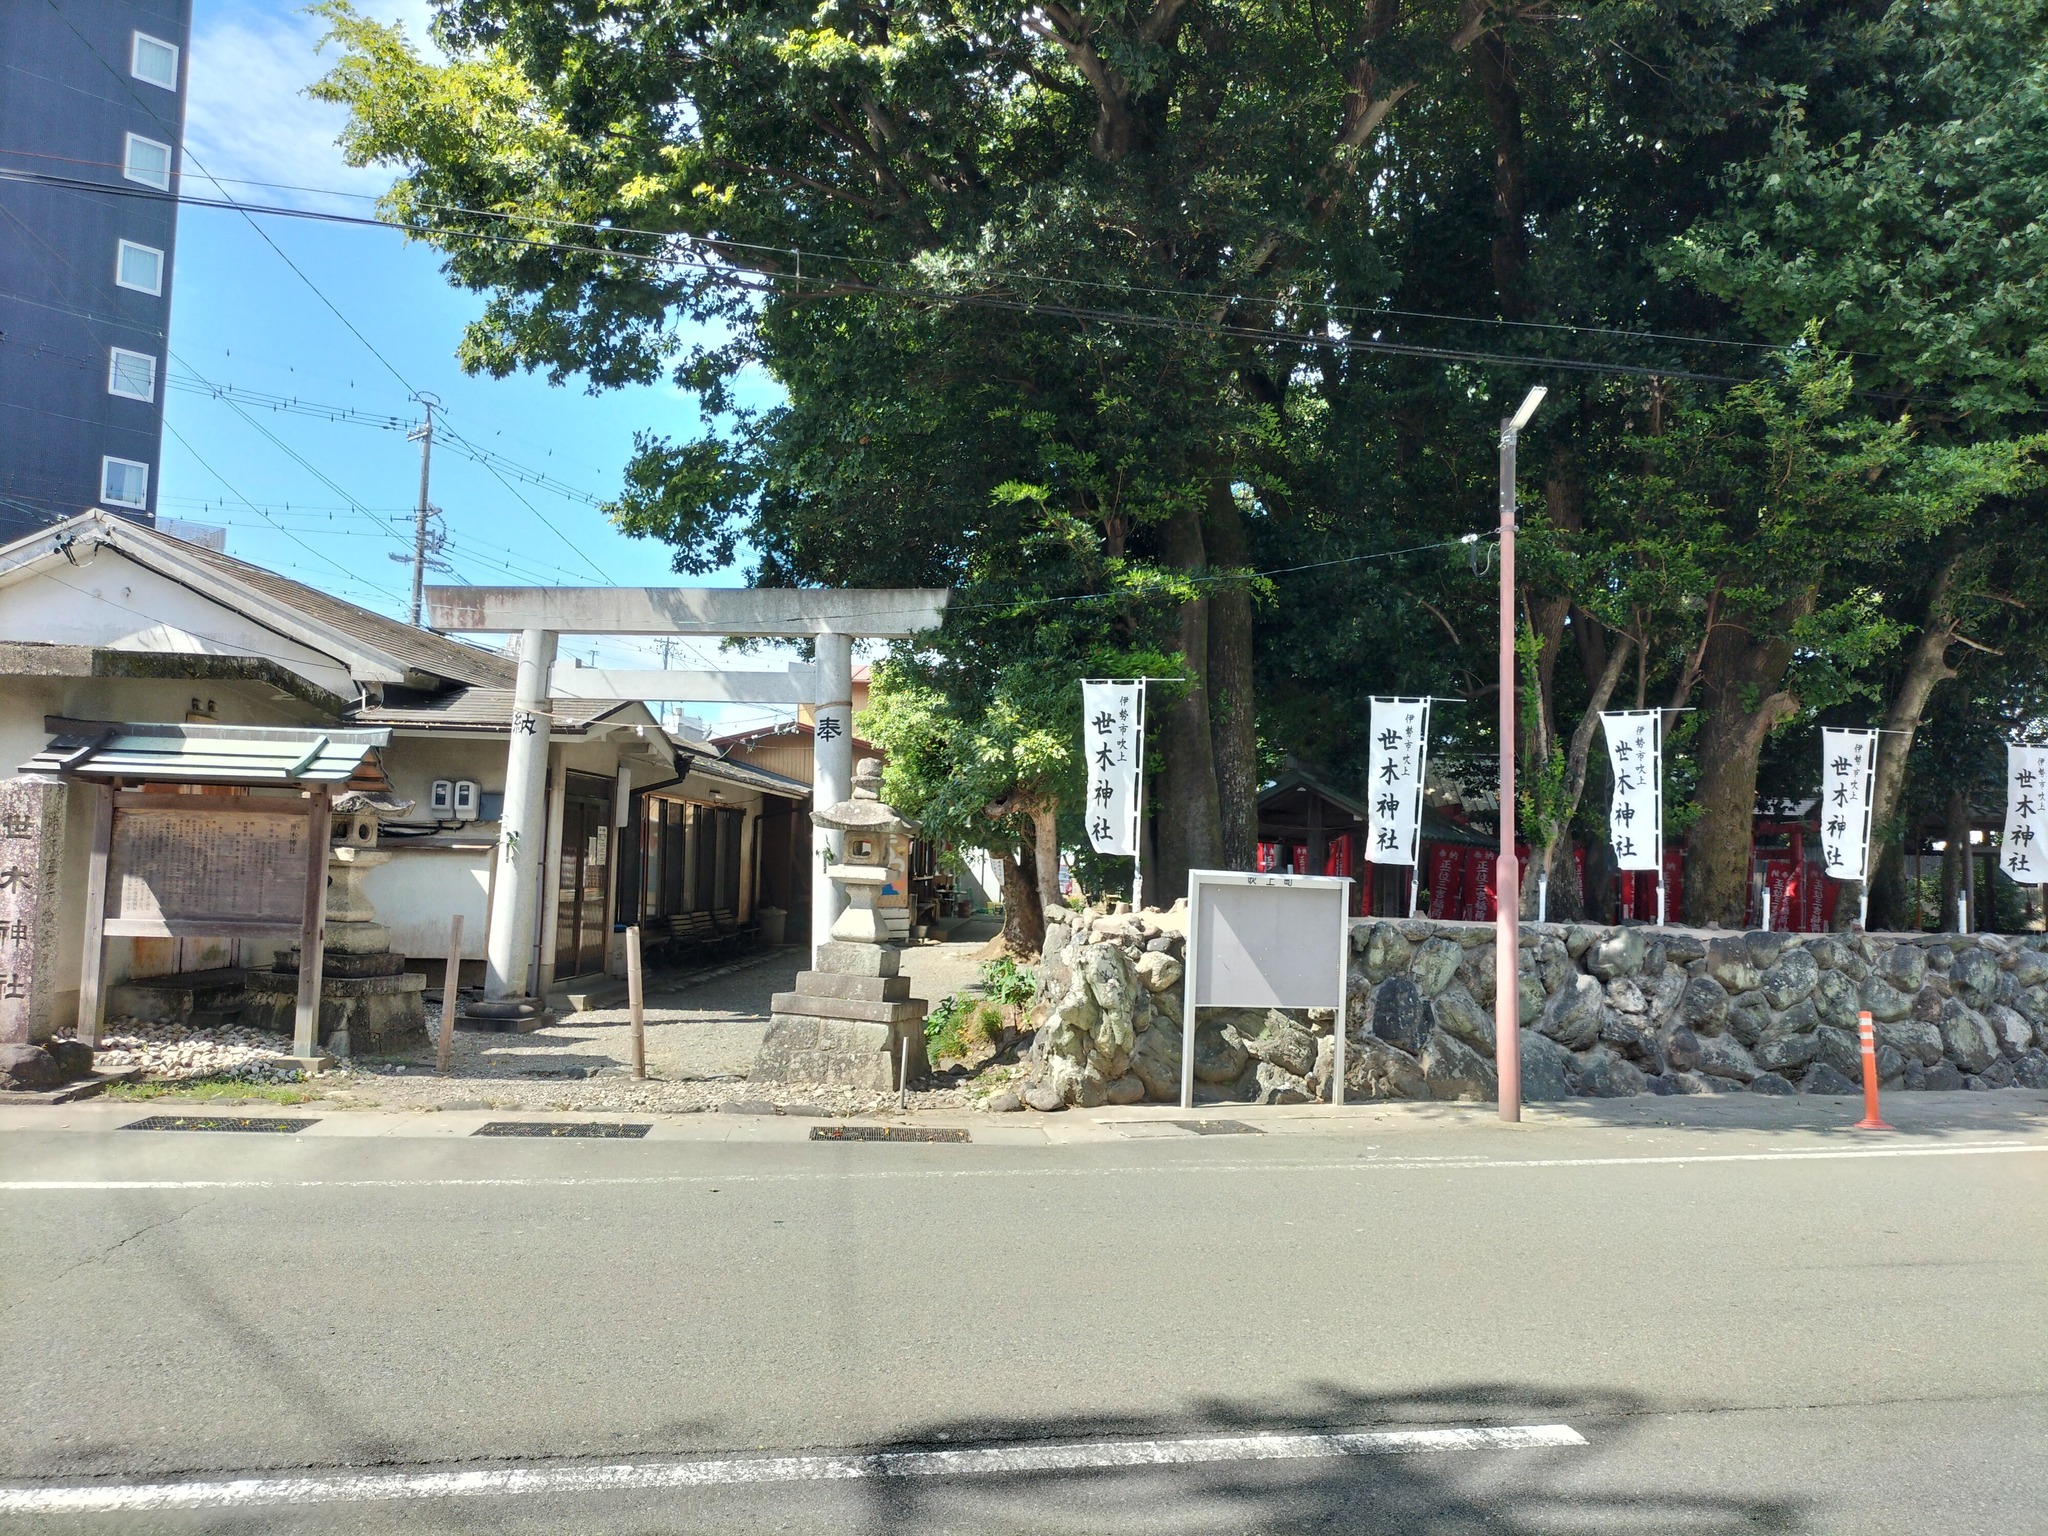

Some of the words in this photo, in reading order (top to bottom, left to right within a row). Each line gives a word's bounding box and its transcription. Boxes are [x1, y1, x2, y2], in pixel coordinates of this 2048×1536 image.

[513, 711, 537, 736] 納
[817, 716, 842, 742] 奉
[1116, 695, 1129, 762] 伊勢市吹上
[1401, 713, 1415, 776] 伊勢市吹上
[1635, 725, 1647, 786] 伊勢市吹上
[1091, 711, 1116, 842] 世木神社
[1375, 727, 1402, 852] 世木神社
[1614, 740, 1637, 859] 世木神社
[1850, 744, 1863, 800] 伊勢市吹上
[2037, 757, 2046, 811] 伊勢市吹上
[1826, 755, 1852, 866] 世木神社
[2007, 768, 2037, 873] 世木神社
[0, 813, 35, 1000] 世木神社
